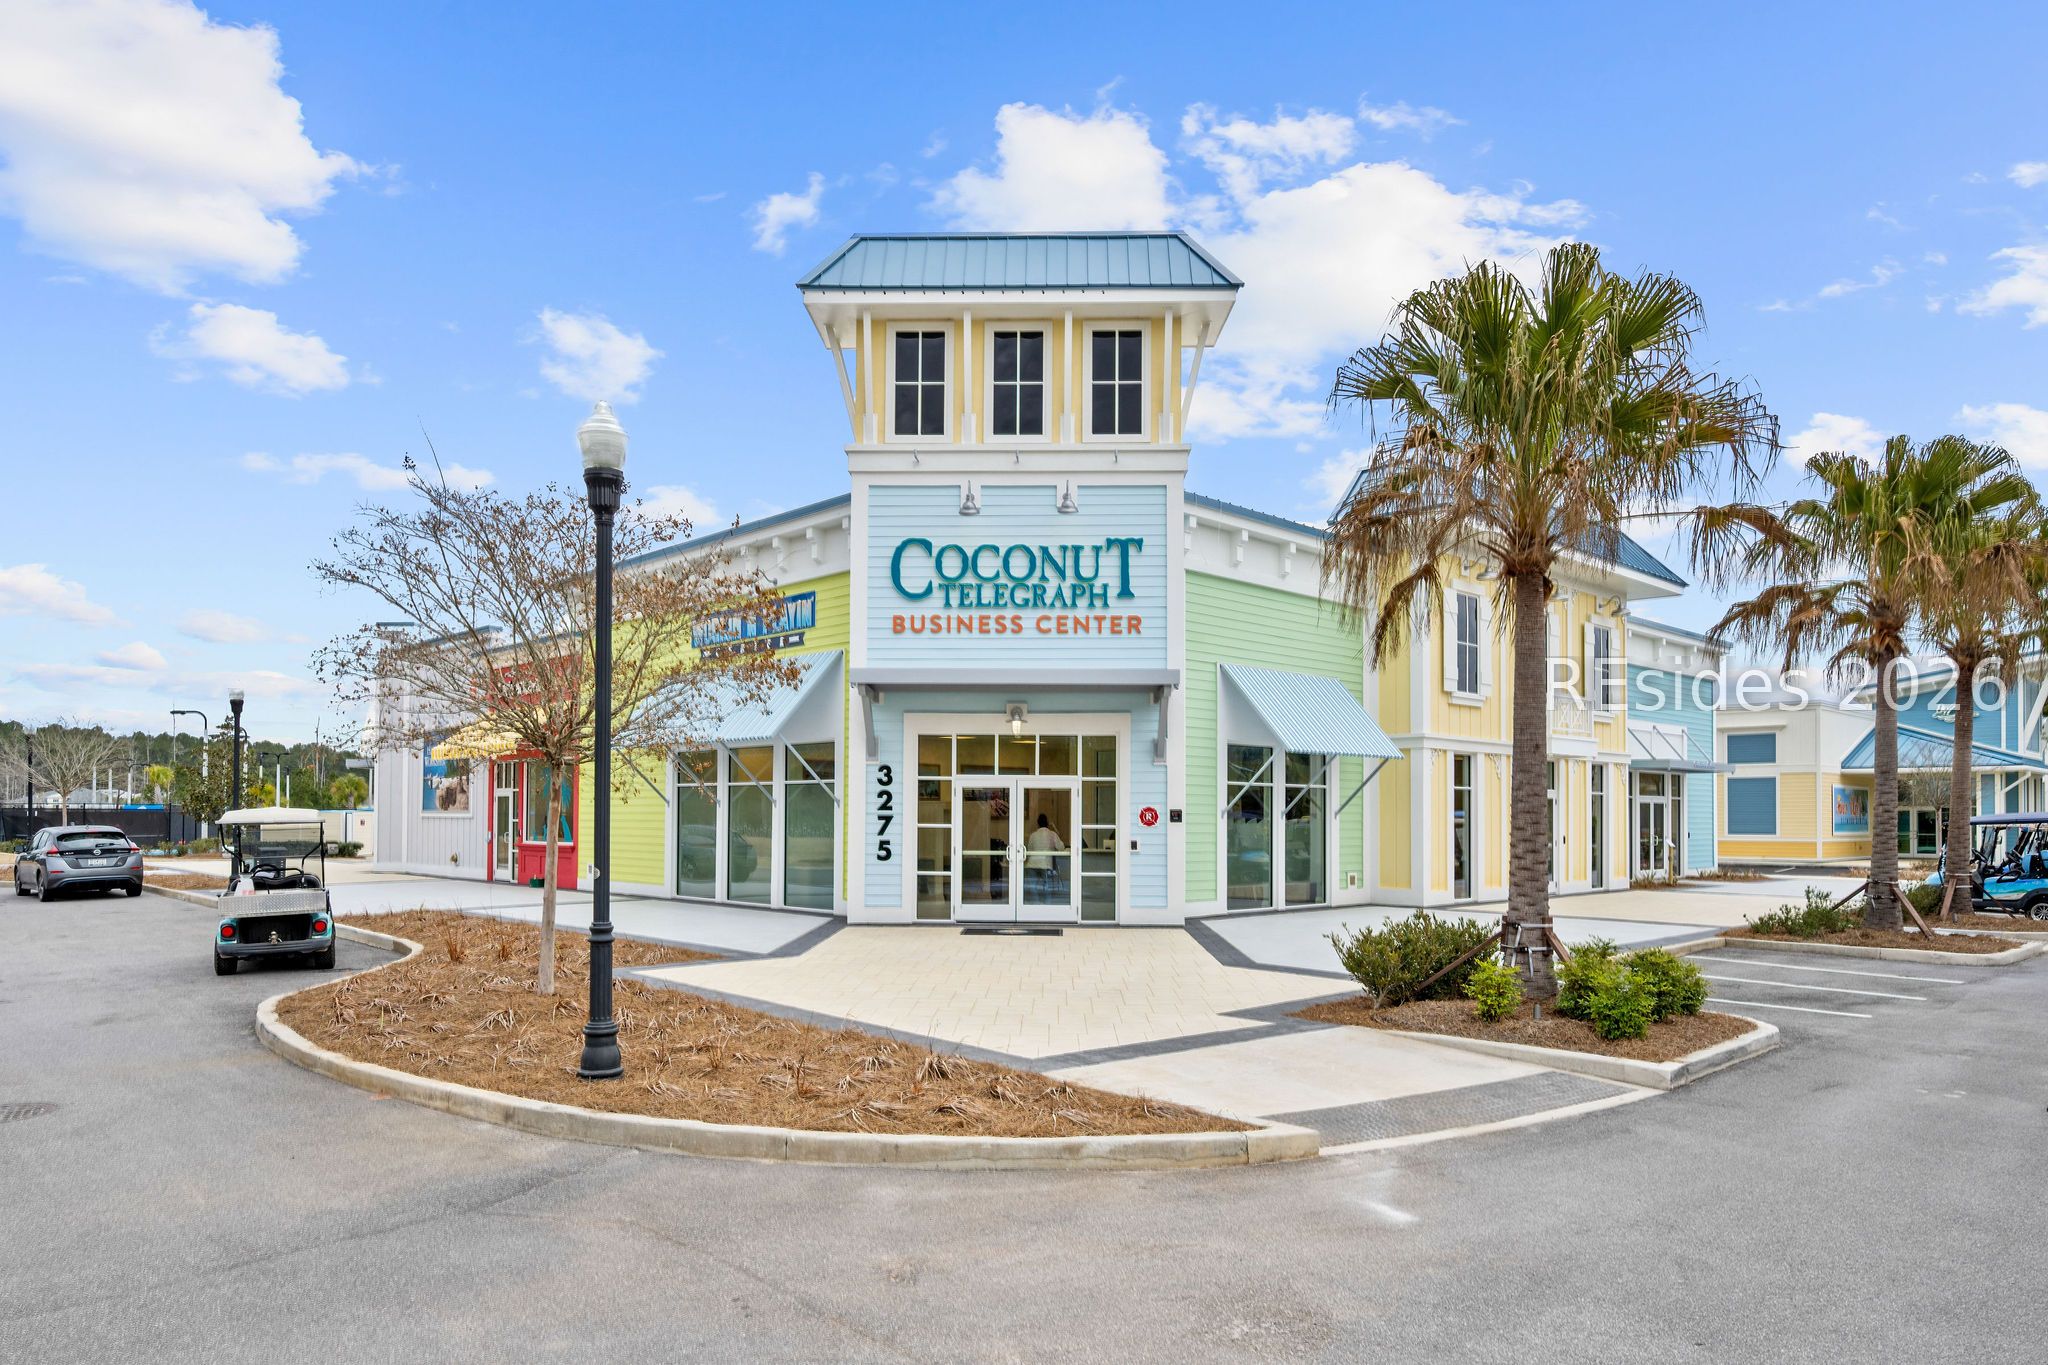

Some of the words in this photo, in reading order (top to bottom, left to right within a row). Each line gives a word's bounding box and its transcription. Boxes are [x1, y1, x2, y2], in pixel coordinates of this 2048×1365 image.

[890, 538, 1144, 600] COCONUT
[938, 583, 1110, 608] TELEGRAPH
[892, 614, 1023, 634] BUSINESS
[1035, 614, 1142, 634] CENTER
[877, 765, 894, 861] 3275
